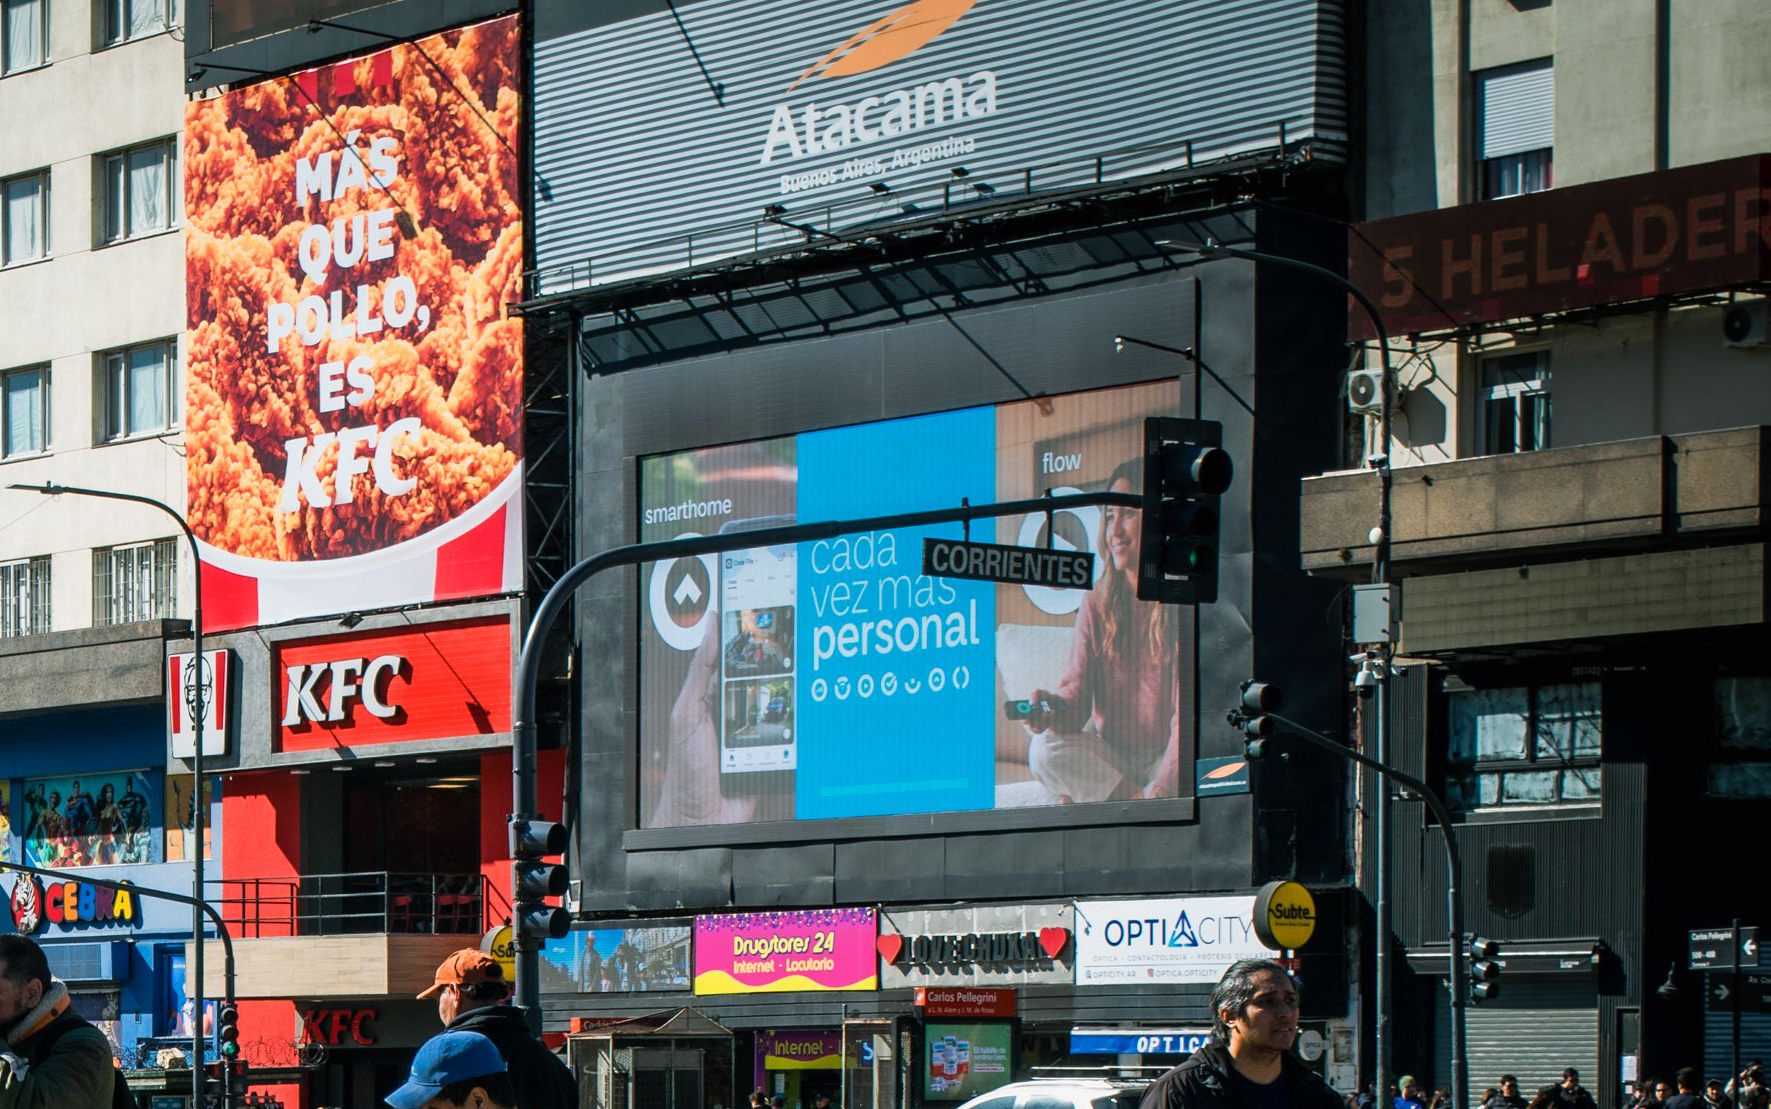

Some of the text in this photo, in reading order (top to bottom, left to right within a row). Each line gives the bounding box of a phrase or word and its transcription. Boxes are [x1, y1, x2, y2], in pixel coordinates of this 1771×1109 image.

[760, 71, 997, 165] Atacama
[296, 129, 398, 207] MÁS
[780, 136, 975, 194] Buenos Aires, Argentina
[298, 208, 394, 284] QUE
[1380, 245, 1414, 308] 5
[267, 276, 430, 354] POLLO,
[318, 355, 375, 413] ES
[280, 417, 421, 513] KFC
[1042, 452, 1082, 473] flow
[645, 499, 732, 524] smarthome
[811, 530, 898, 574] cada
[932, 543, 1089, 585] CORRIENTES
[811, 580, 868, 617] vez
[813, 598, 979, 671] personal
[281, 655, 401, 726] KFC
[45, 881, 132, 923] CEBRA
[1273, 903, 1310, 919] Subte
[734, 932, 835, 959] Drugstores 24
[734, 960, 774, 974] Internet
[786, 958, 834, 972] Locutorio
[928, 992, 997, 1005] Carlos Pellegrini
[305, 1009, 375, 1046] KFC
[775, 1040, 824, 1055] Internet
